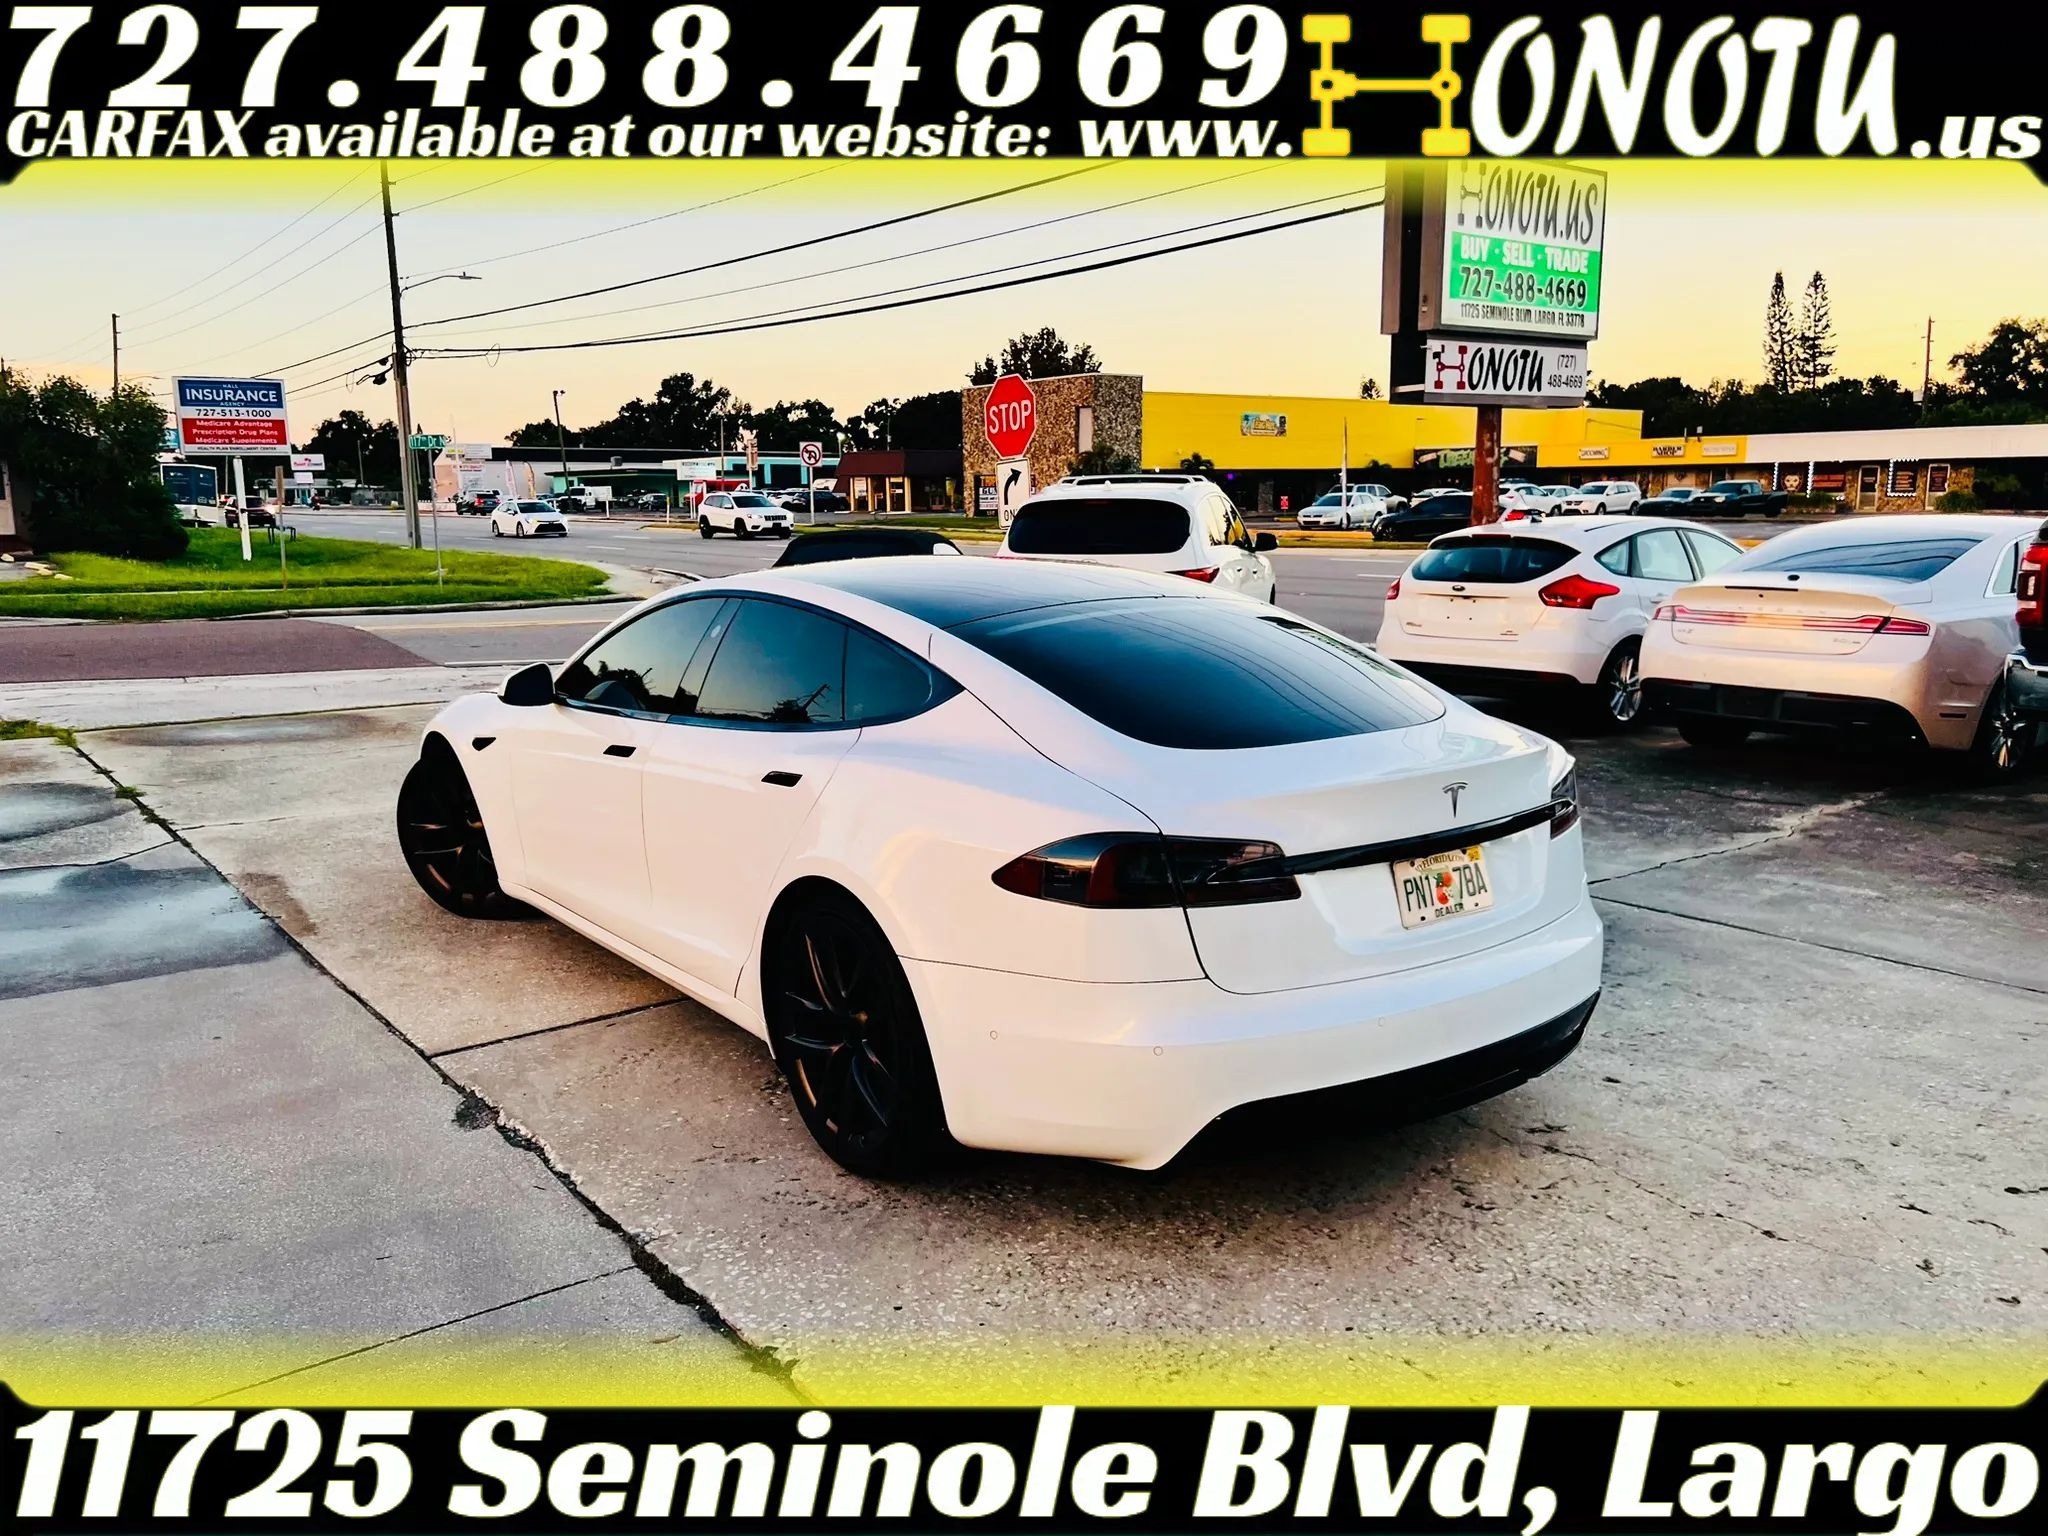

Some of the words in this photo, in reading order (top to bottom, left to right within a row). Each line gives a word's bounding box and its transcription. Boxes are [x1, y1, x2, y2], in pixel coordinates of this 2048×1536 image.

[1460, 235, 1491, 262] BUY
[1502, 241, 1535, 267] SELL
[1545, 246, 1589, 274] TRADE
[1460, 265, 1587, 308] 727-488-4669
[1461, 303, 1481, 319] 11725
[1482, 306, 1514, 322] SEMINOLE
[1558, 313, 1565, 327] FL
[1566, 314, 1585, 328] 33778
[1556, 353, 1578, 372] (727)
[1547, 374, 1583, 389] 488-4669
[185, 388, 278, 402] INSURANCE
[195, 408, 272, 418] 727-513-1000
[989, 399, 1032, 434] STOP
[233, 420, 273, 428] Advantage
[192, 428, 237, 436] Prescription
[238, 429, 258, 437] Drug
[231, 437, 278, 445] Supplements
[428, 435, 437, 447] Dr
[1003, 508, 1019, 521] ON
[1434, 903, 1465, 918] DEALER
